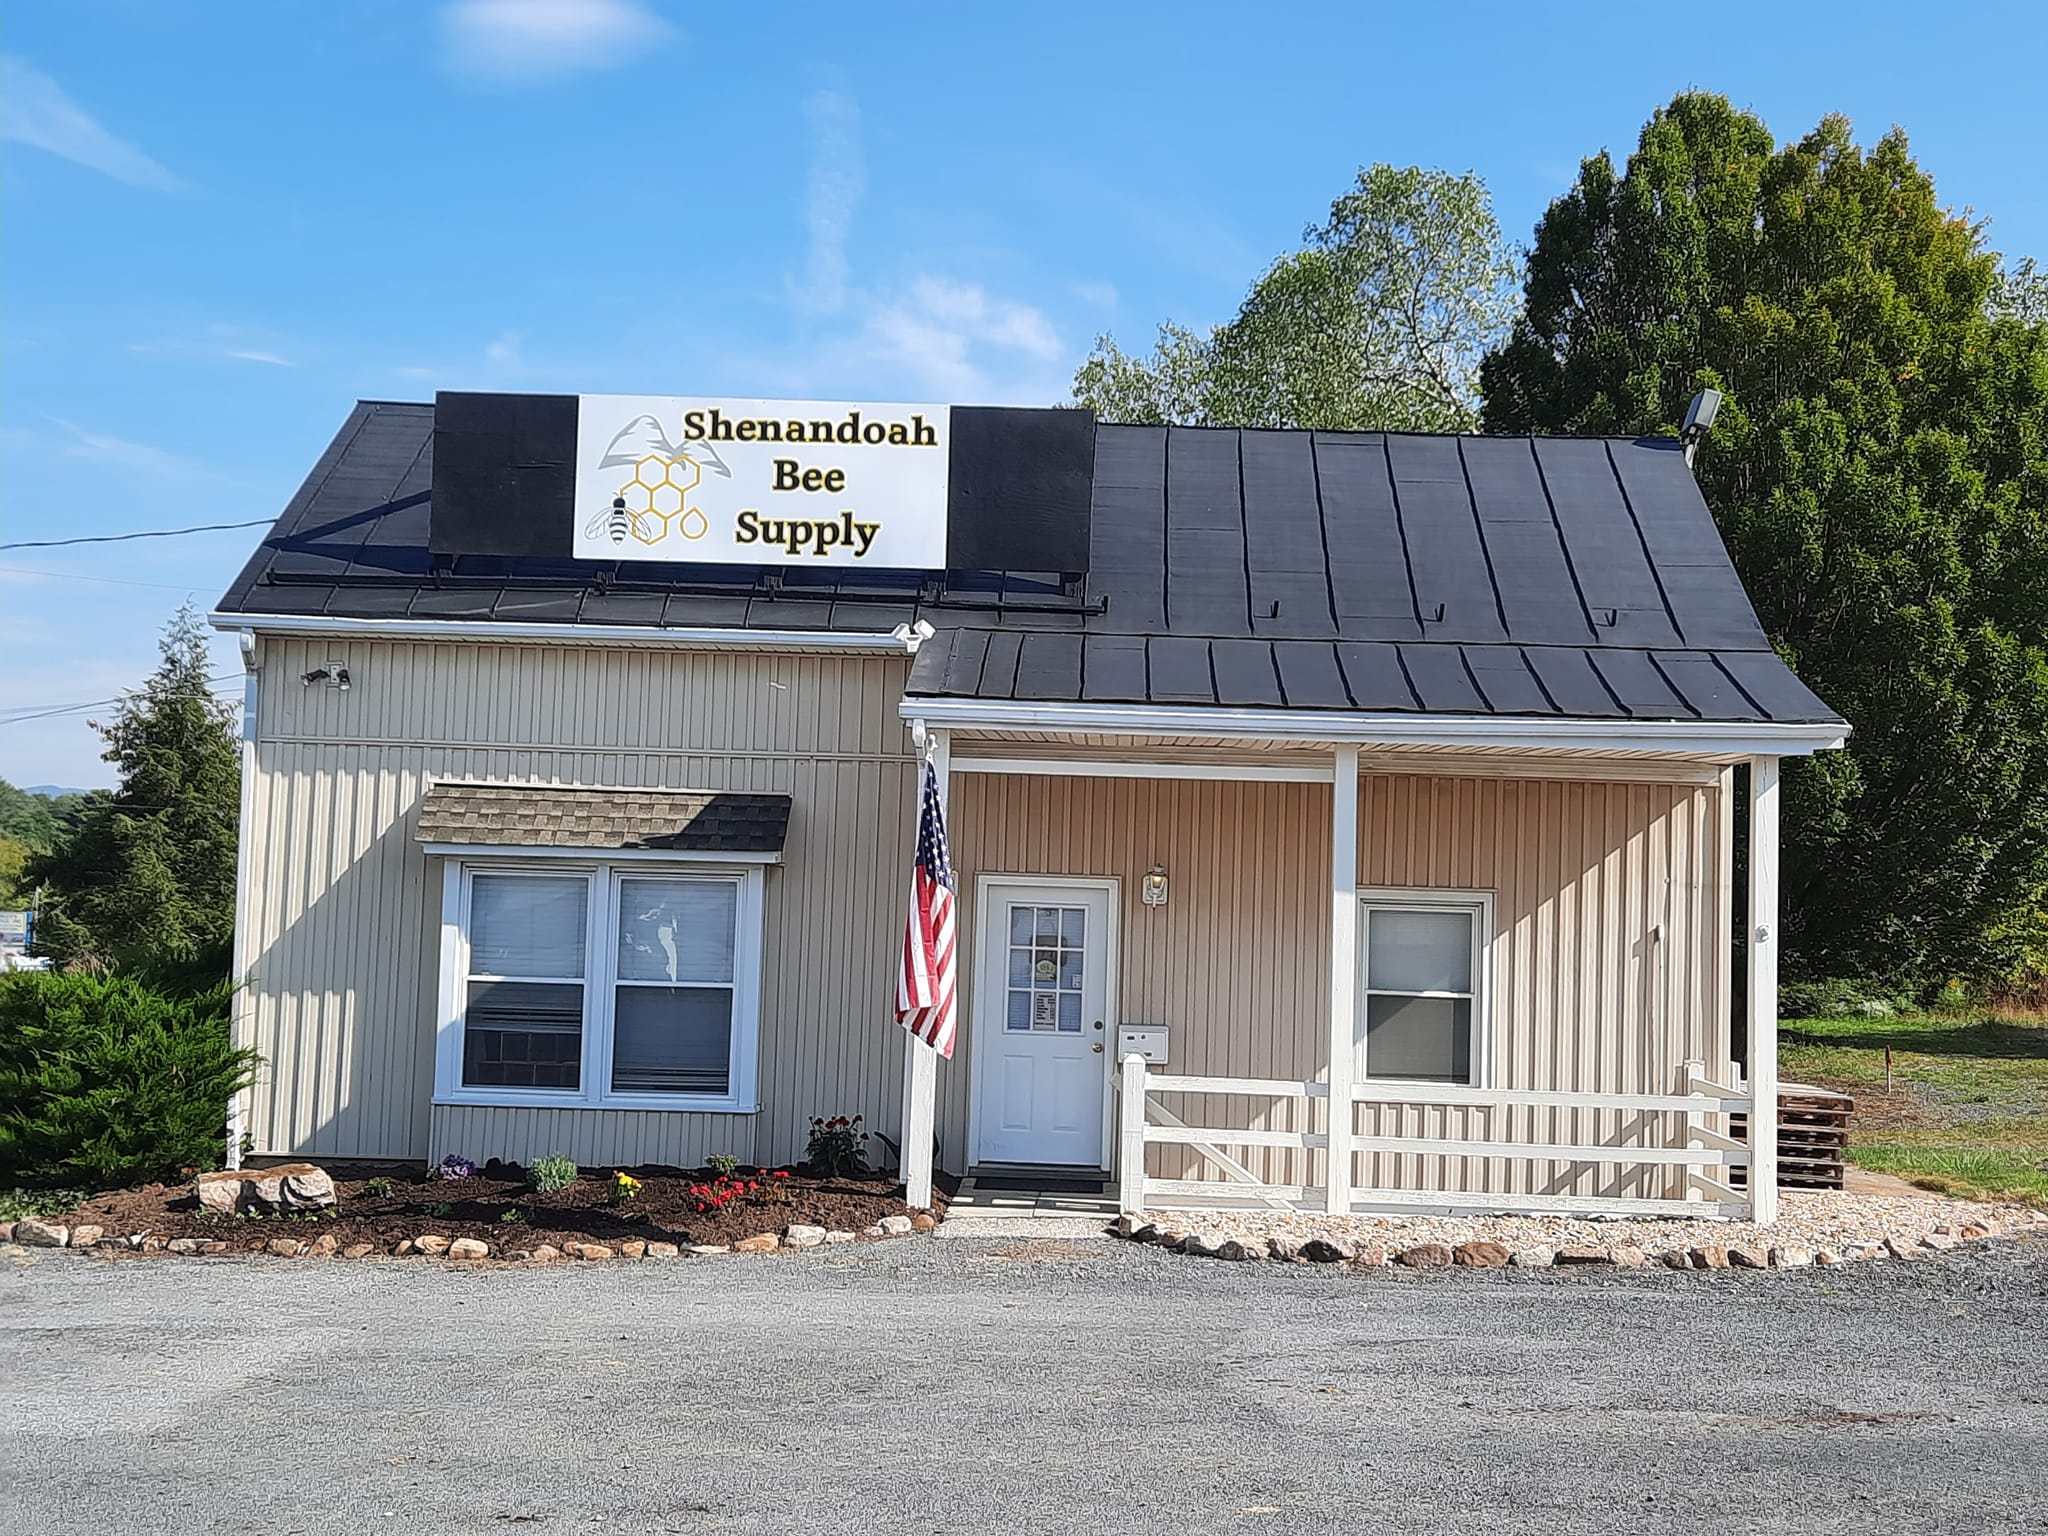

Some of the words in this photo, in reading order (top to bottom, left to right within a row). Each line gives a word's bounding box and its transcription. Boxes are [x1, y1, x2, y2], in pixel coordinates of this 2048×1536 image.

[684, 409, 938, 446] Shenandoah
[772, 459, 846, 493] Bee
[736, 511, 880, 558] Supply
